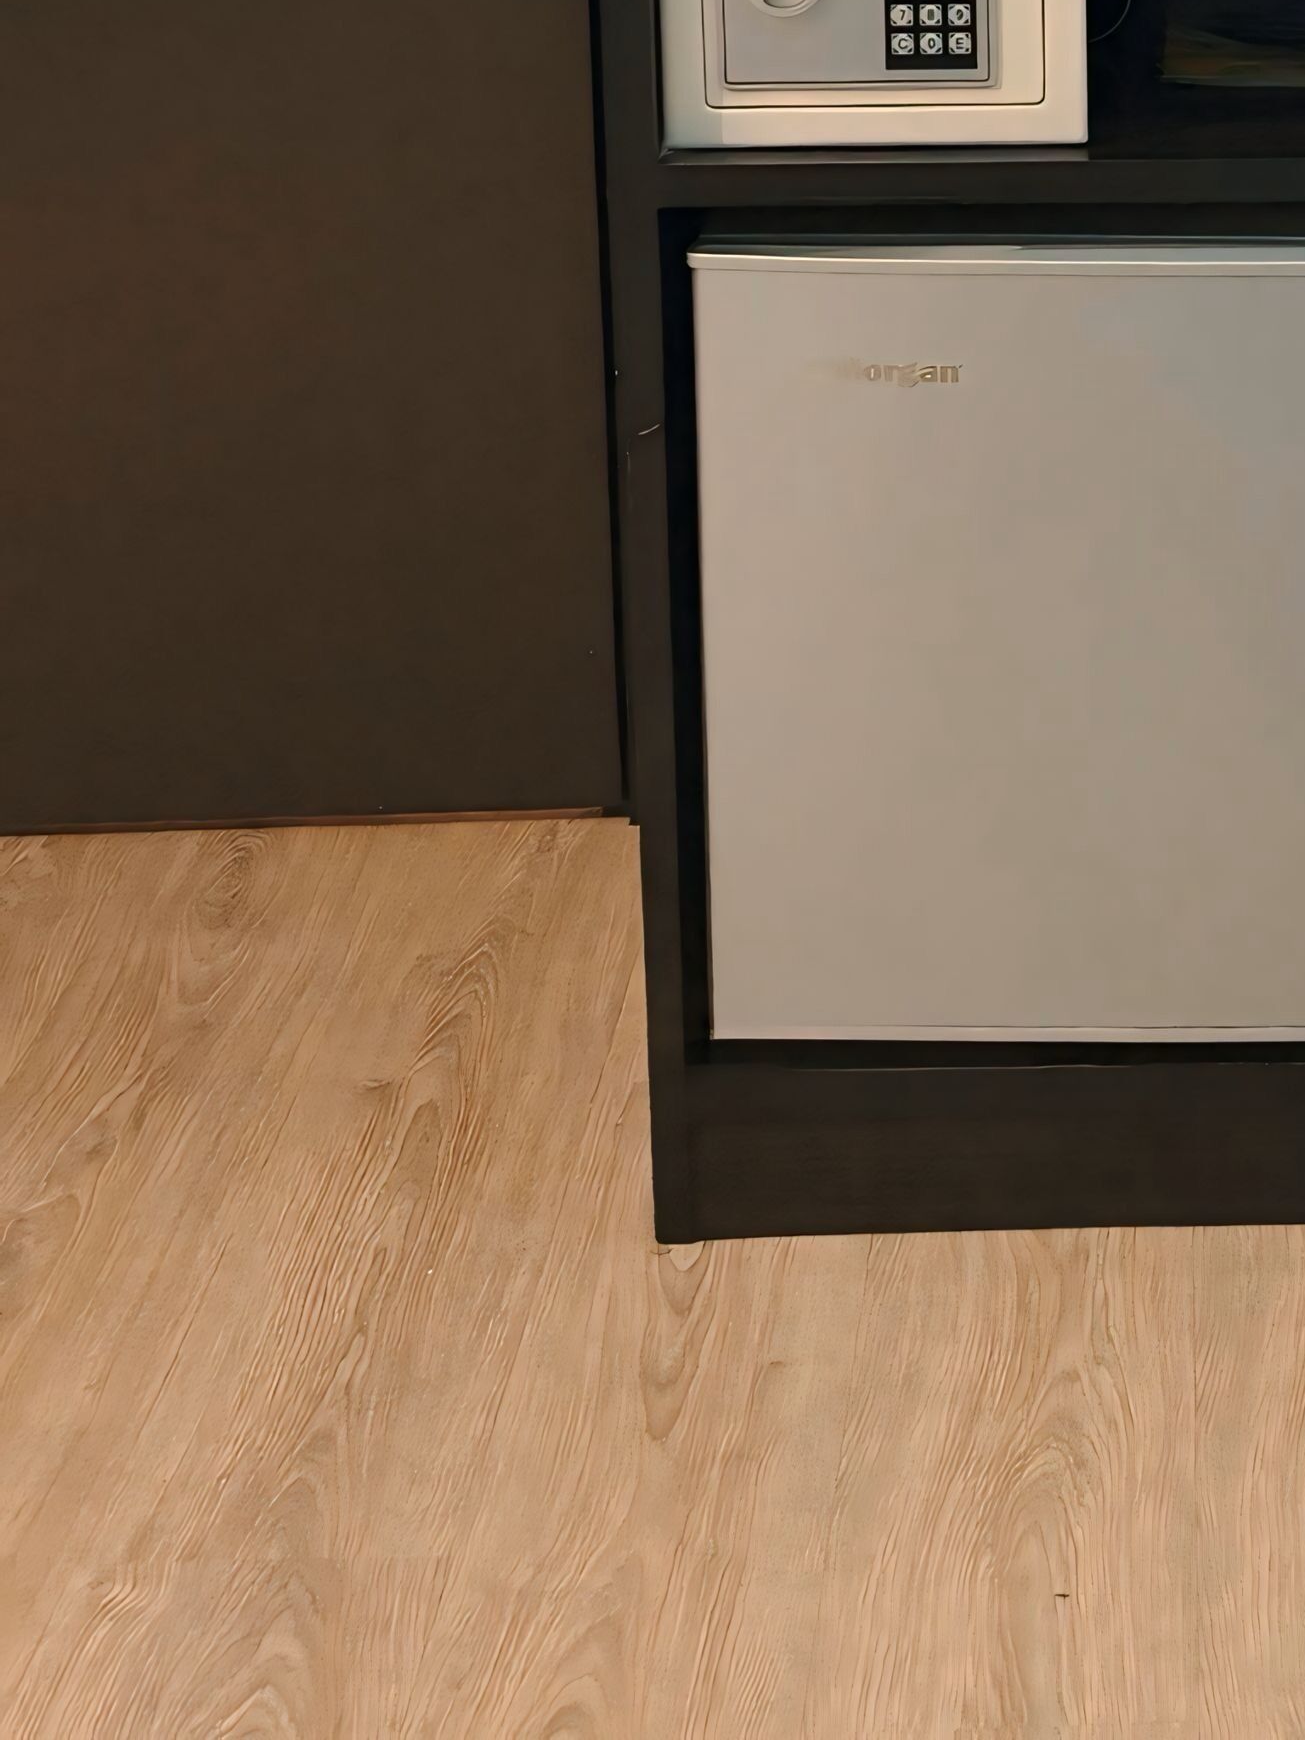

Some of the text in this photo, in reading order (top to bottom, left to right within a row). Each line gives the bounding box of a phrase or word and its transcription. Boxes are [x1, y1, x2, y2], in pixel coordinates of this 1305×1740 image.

[897, 37, 909, 50] C
[955, 37, 964, 50] E
[840, 358, 960, 388] organ
